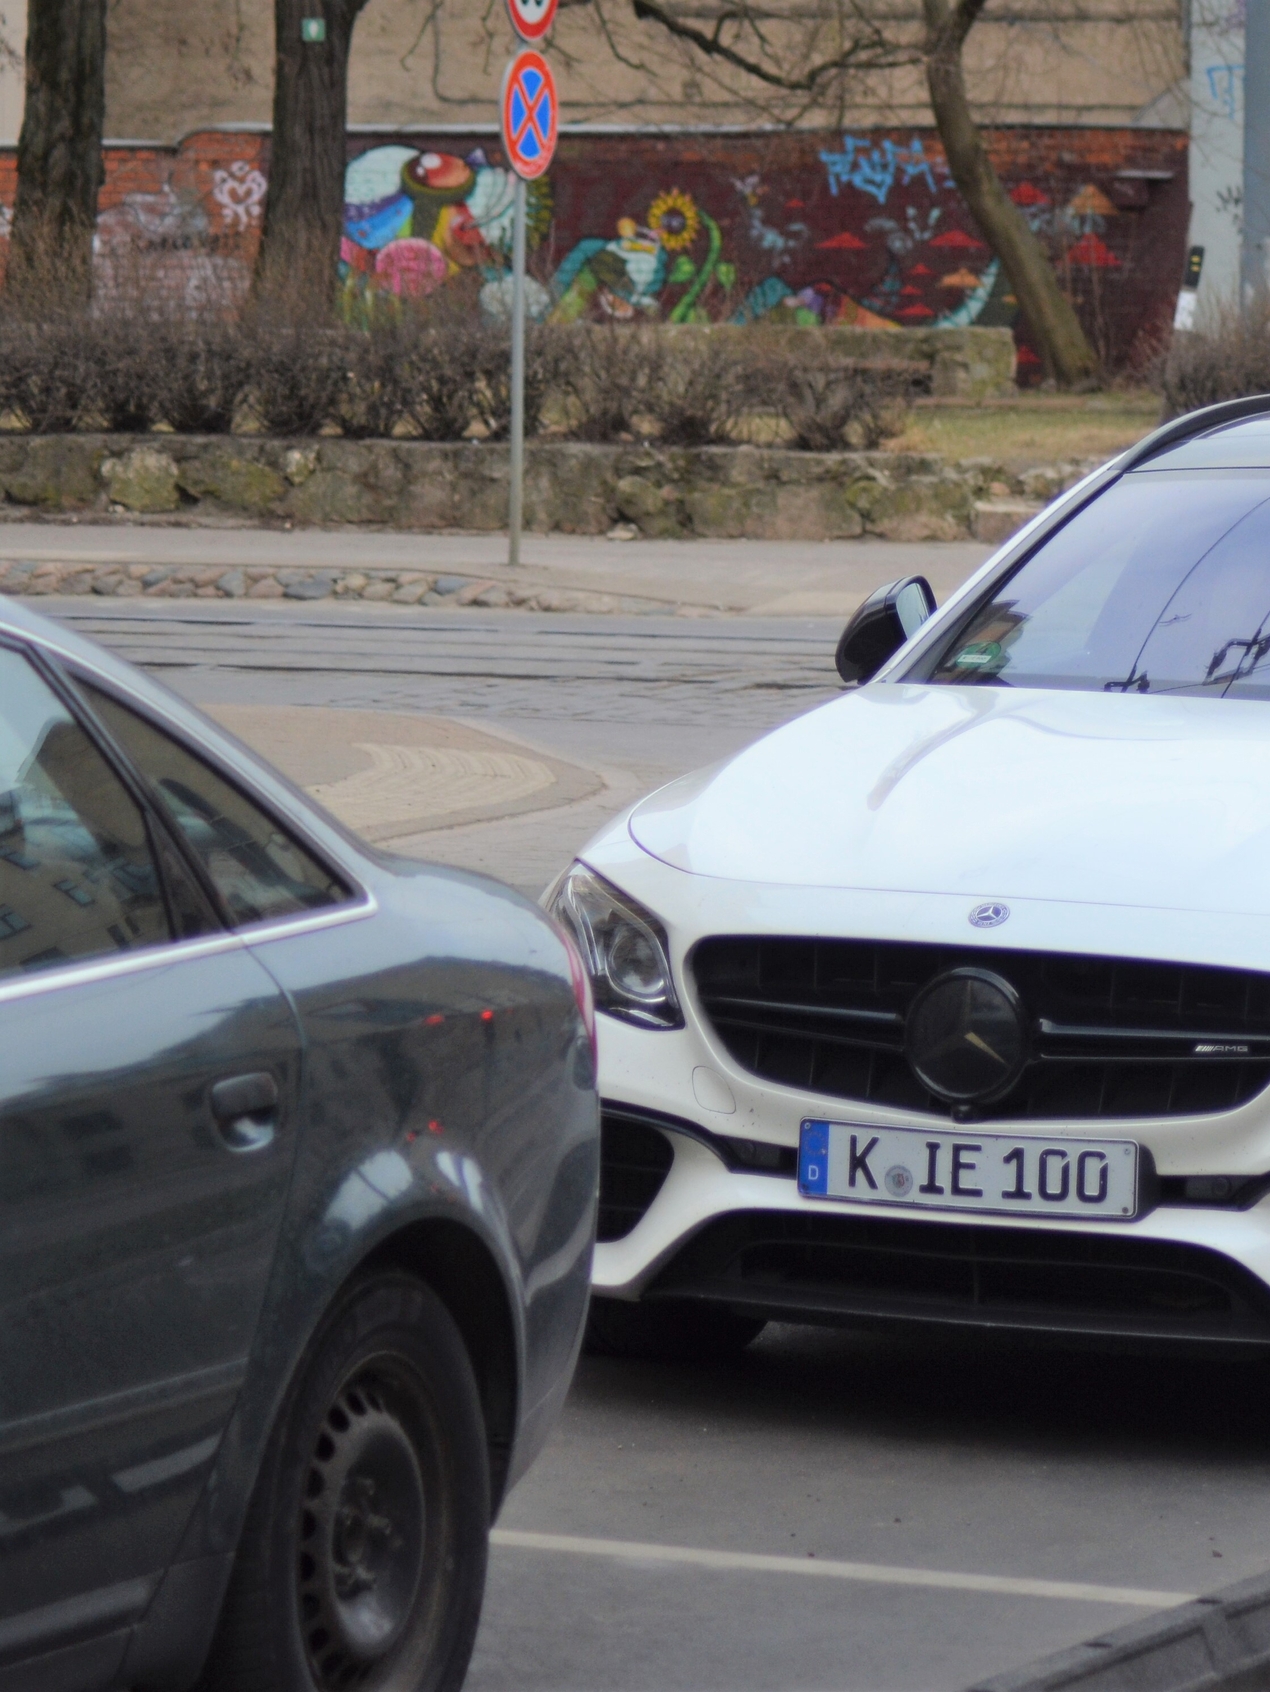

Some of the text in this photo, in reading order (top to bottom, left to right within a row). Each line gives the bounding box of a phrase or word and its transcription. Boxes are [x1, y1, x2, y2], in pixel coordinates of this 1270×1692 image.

[807, 1165, 819, 1181] D
[848, 1134, 1109, 1203] K IE 100
